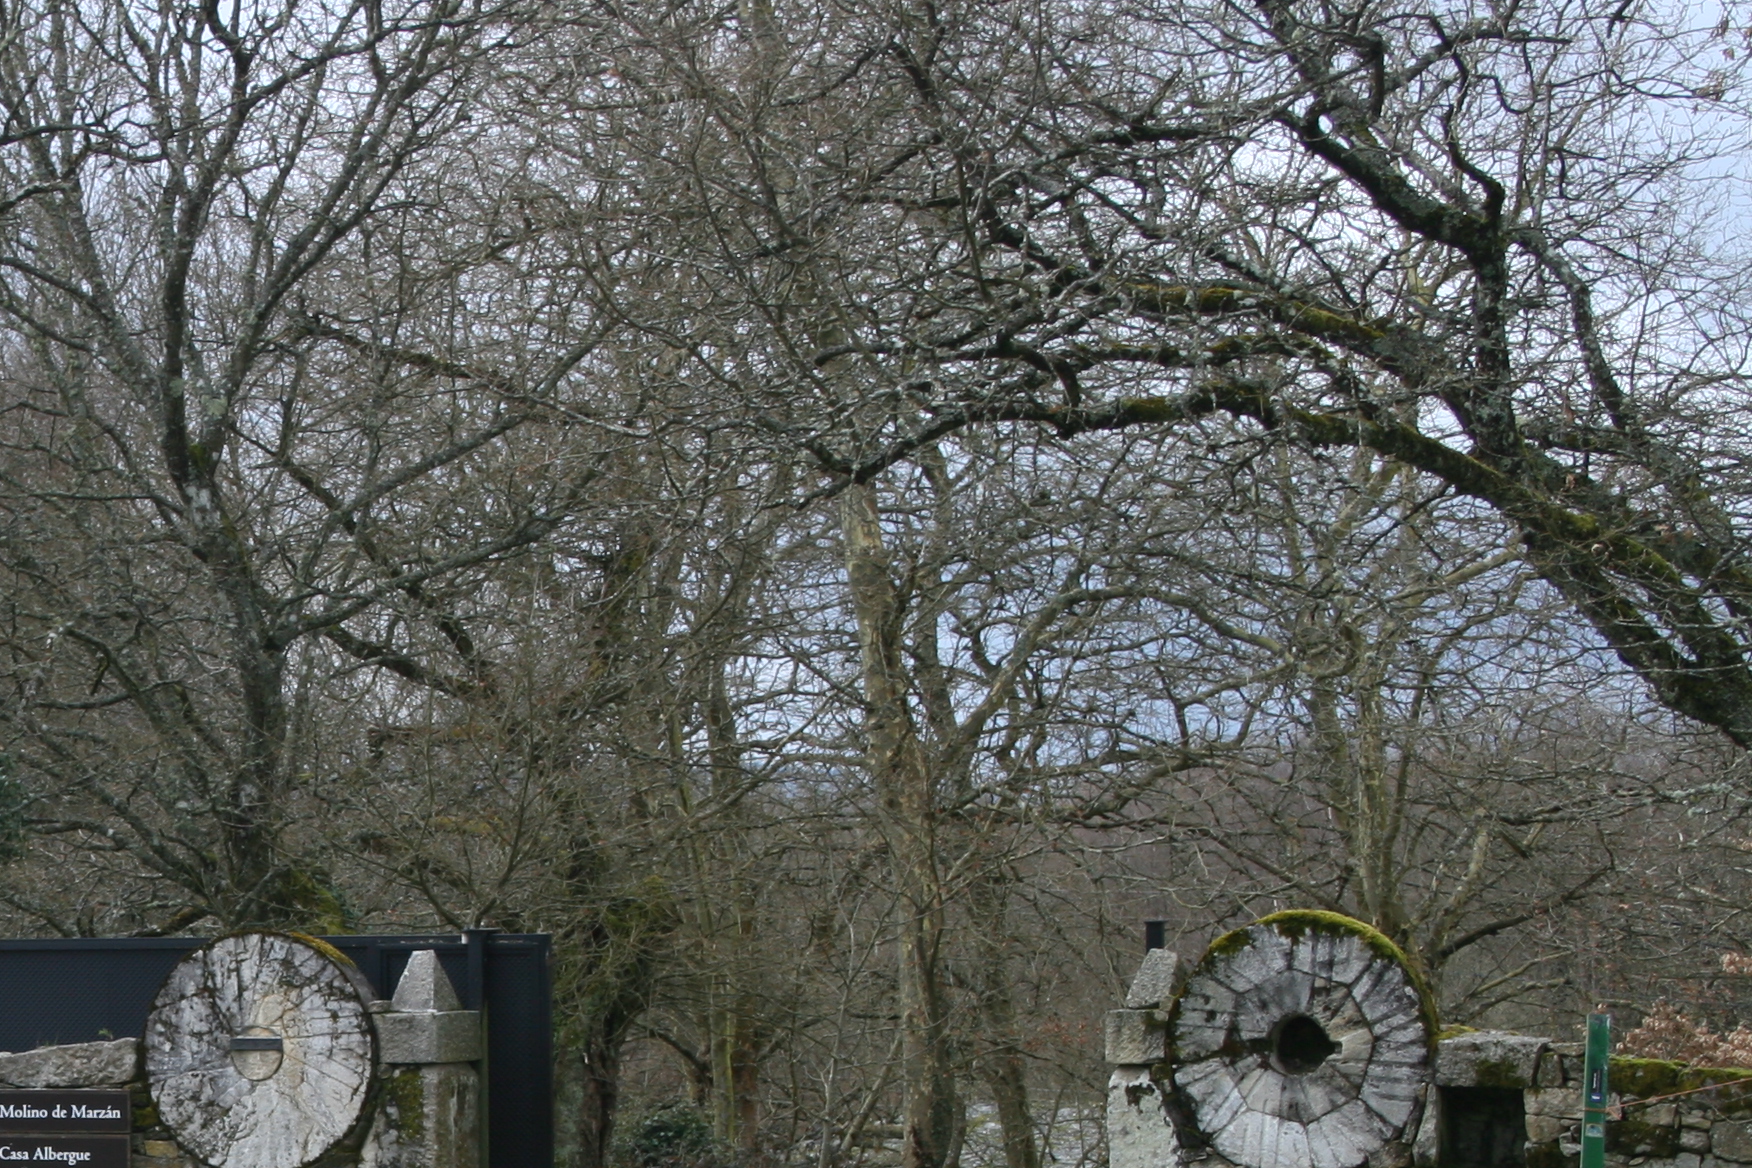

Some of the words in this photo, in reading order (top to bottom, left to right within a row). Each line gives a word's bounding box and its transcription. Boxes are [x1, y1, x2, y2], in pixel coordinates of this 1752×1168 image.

[0, 1104, 48, 1119] Molino
[52, 1104, 67, 1119] de
[71, 1104, 121, 1119] Marzán
[33, 1146, 91, 1166] Albergue
